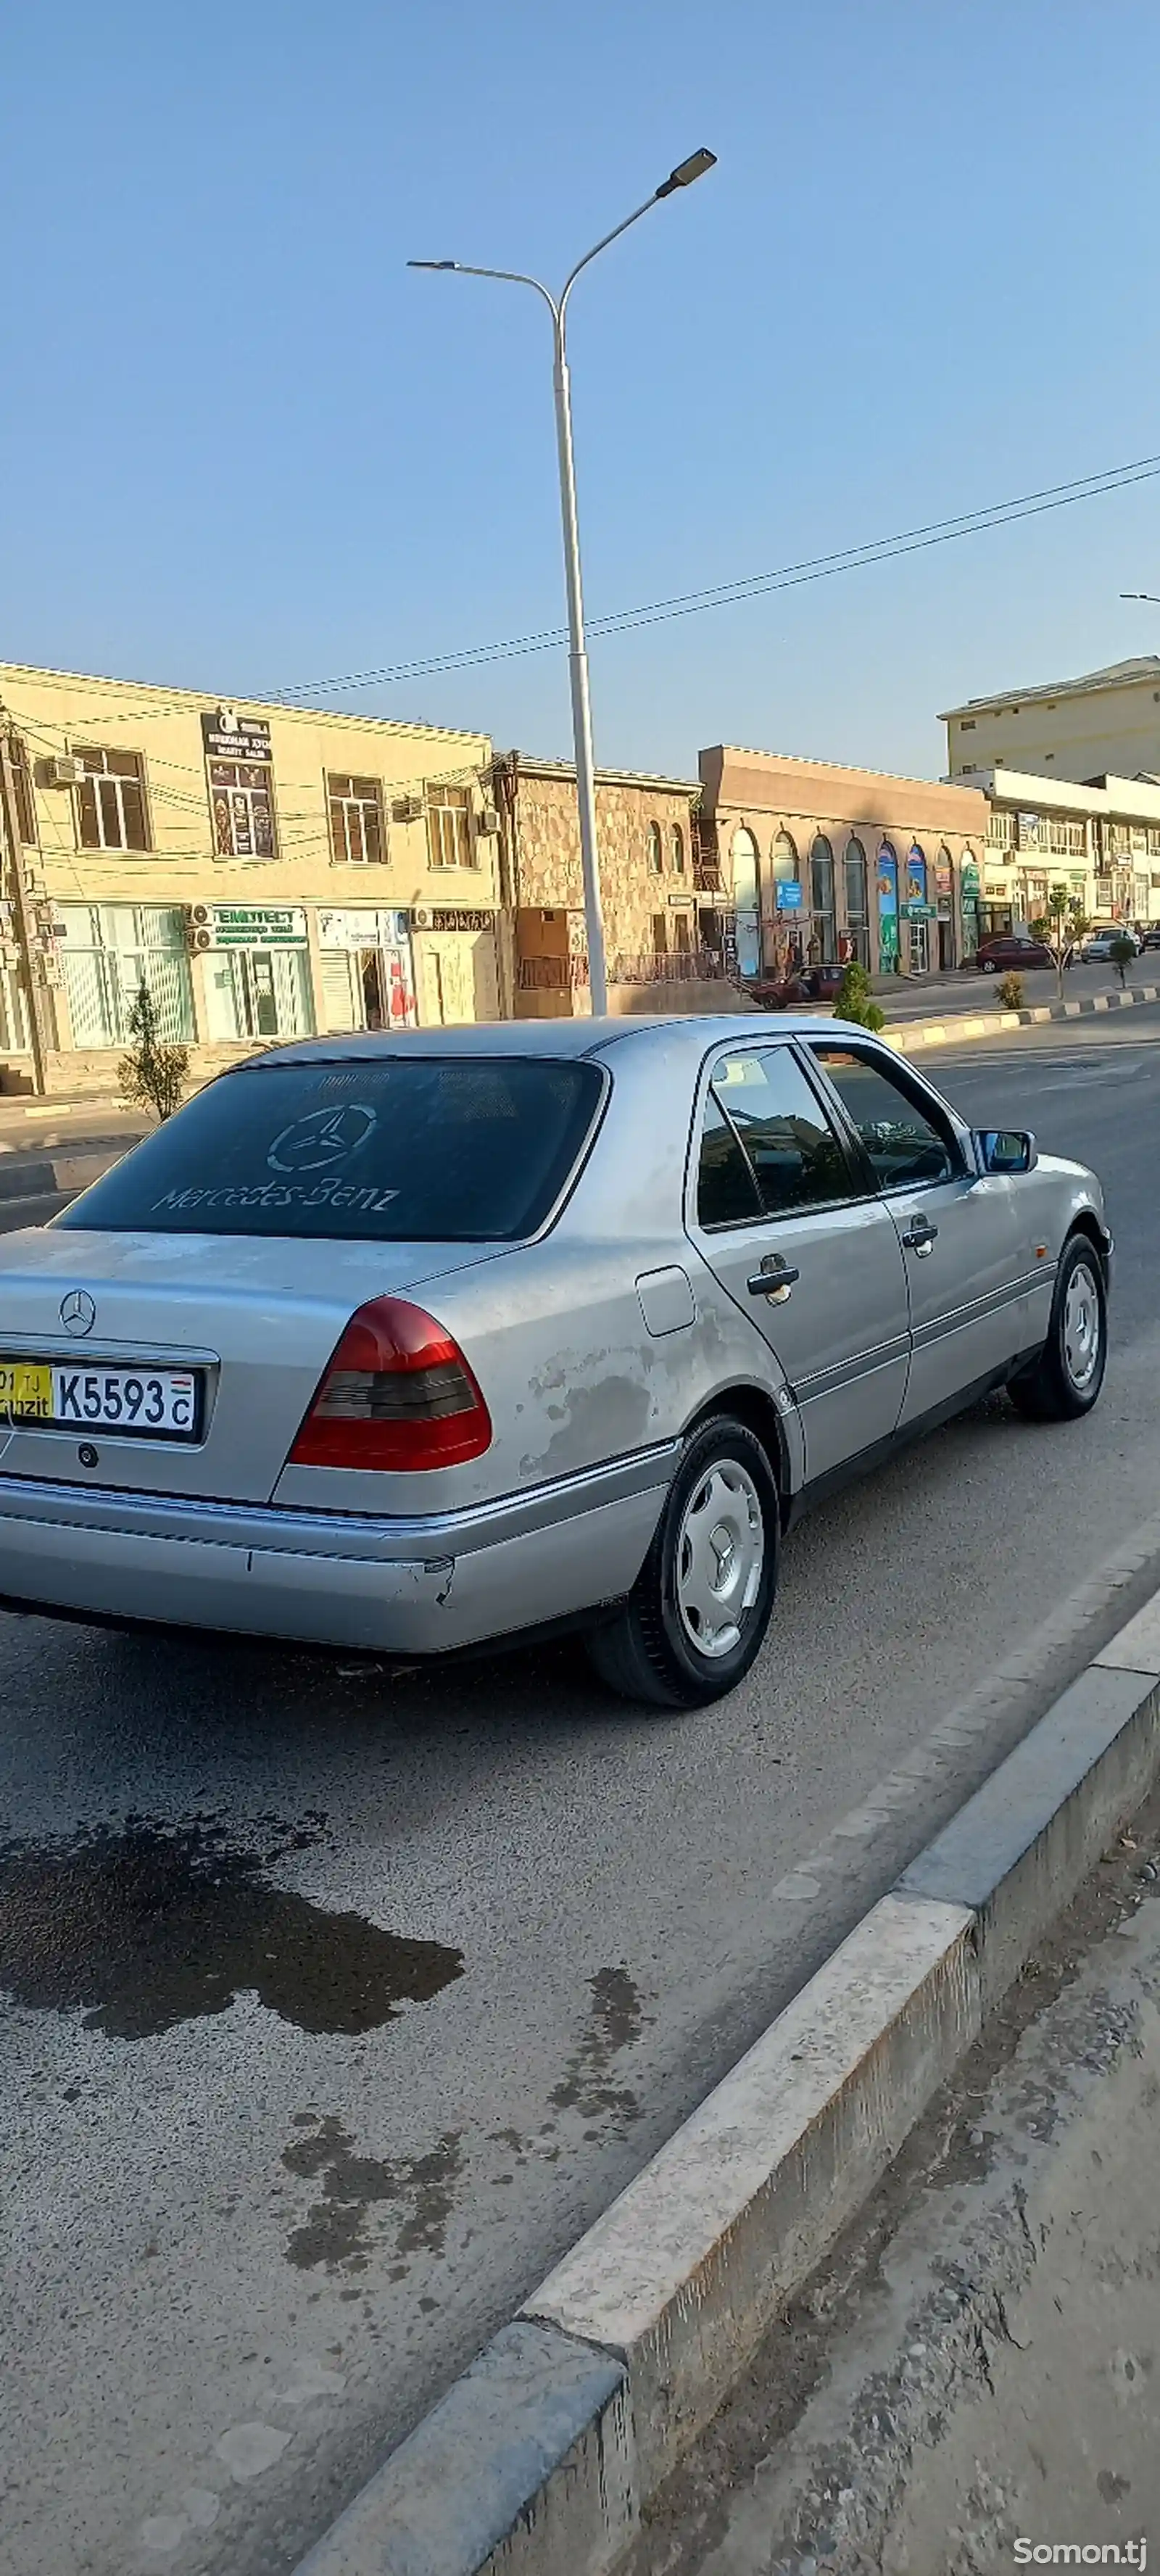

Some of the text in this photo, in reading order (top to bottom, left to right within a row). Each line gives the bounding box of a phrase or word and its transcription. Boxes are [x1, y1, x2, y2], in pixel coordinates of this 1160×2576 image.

[150, 1177, 400, 1212] Mercedes-Benz
[22, 1375, 40, 1393] TJ
[59, 1375, 165, 1423] K5593
